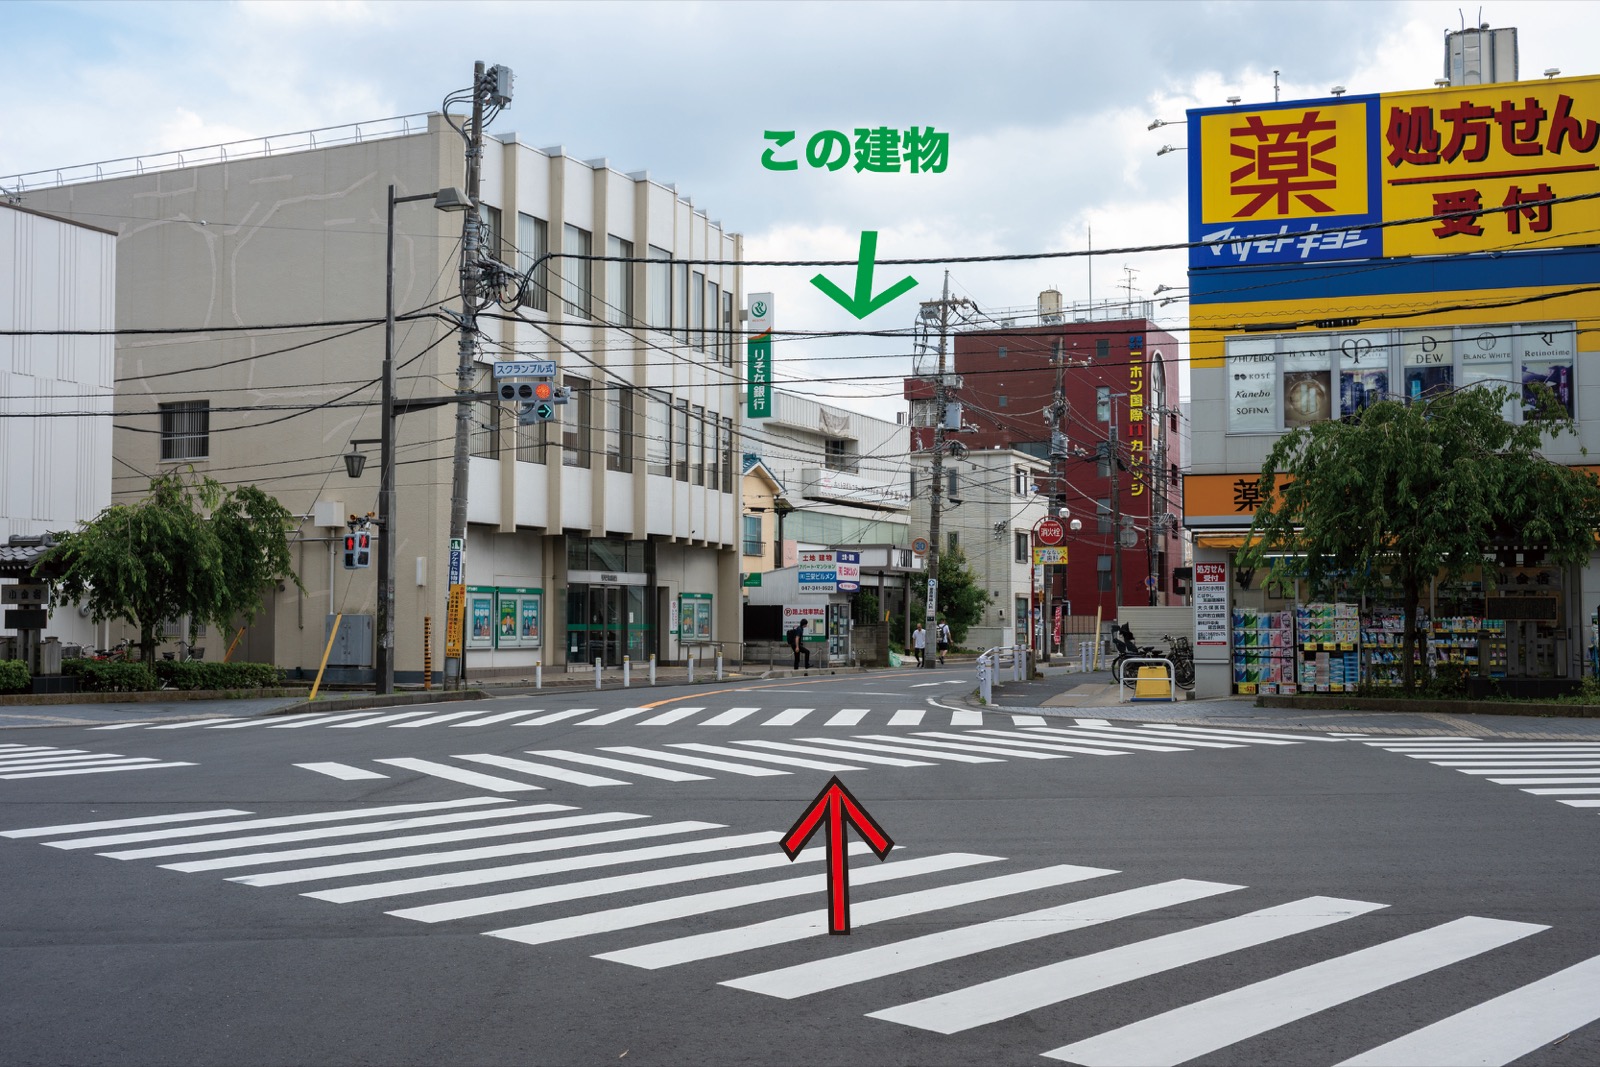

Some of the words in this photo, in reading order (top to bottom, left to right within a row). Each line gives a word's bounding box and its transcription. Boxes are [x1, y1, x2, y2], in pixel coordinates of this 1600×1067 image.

[1386, 94, 1600, 168] 処方せん
[1230, 111, 1337, 218] 薬
[1432, 183, 1556, 239] 受付
[1201, 223, 1369, 262] マツモトキヨシ
[1525, 348, 1571, 358] Retinotime
[1232, 354, 1276, 364] SHISEIDO
[1416, 353, 1444, 365] DEW
[497, 364, 553, 375] スクランブル式
[753, 349, 766, 410] りそな銀行
[1234, 389, 1271, 399] Kanebo
[1236, 406, 1270, 416] SOFINA
[1129, 351, 1145, 497] ニホン国際ITカレッジ
[1041, 528, 1061, 537] 消火栓
[915, 542, 926, 550] 30
[1197, 564, 1225, 574] 処方せん
[1203, 574, 1219, 582] 受付
